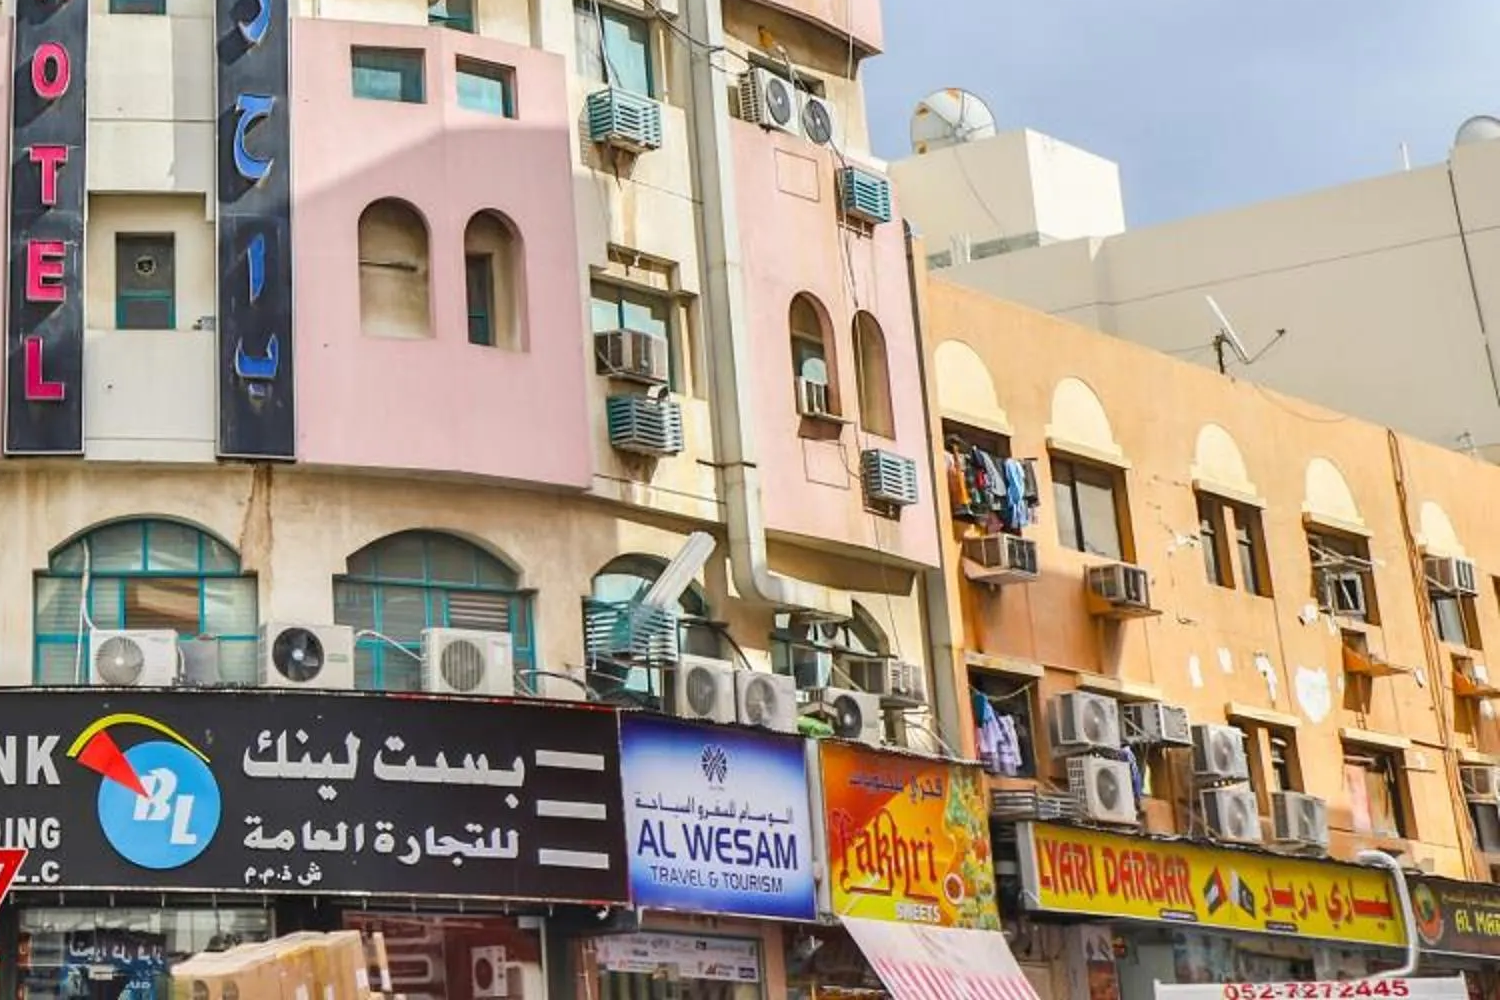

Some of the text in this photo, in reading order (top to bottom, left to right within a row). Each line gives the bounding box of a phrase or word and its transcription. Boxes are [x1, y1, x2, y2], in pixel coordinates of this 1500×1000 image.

[242, 728, 525, 809] بست لينك
[242, 815, 520, 867] للتجارة العامة
[637, 818, 798, 871] AL WESAM
[650, 865, 784, 894] TRAVEL & TOURISM
[1035, 836, 1196, 910] LYARI DARBAR
